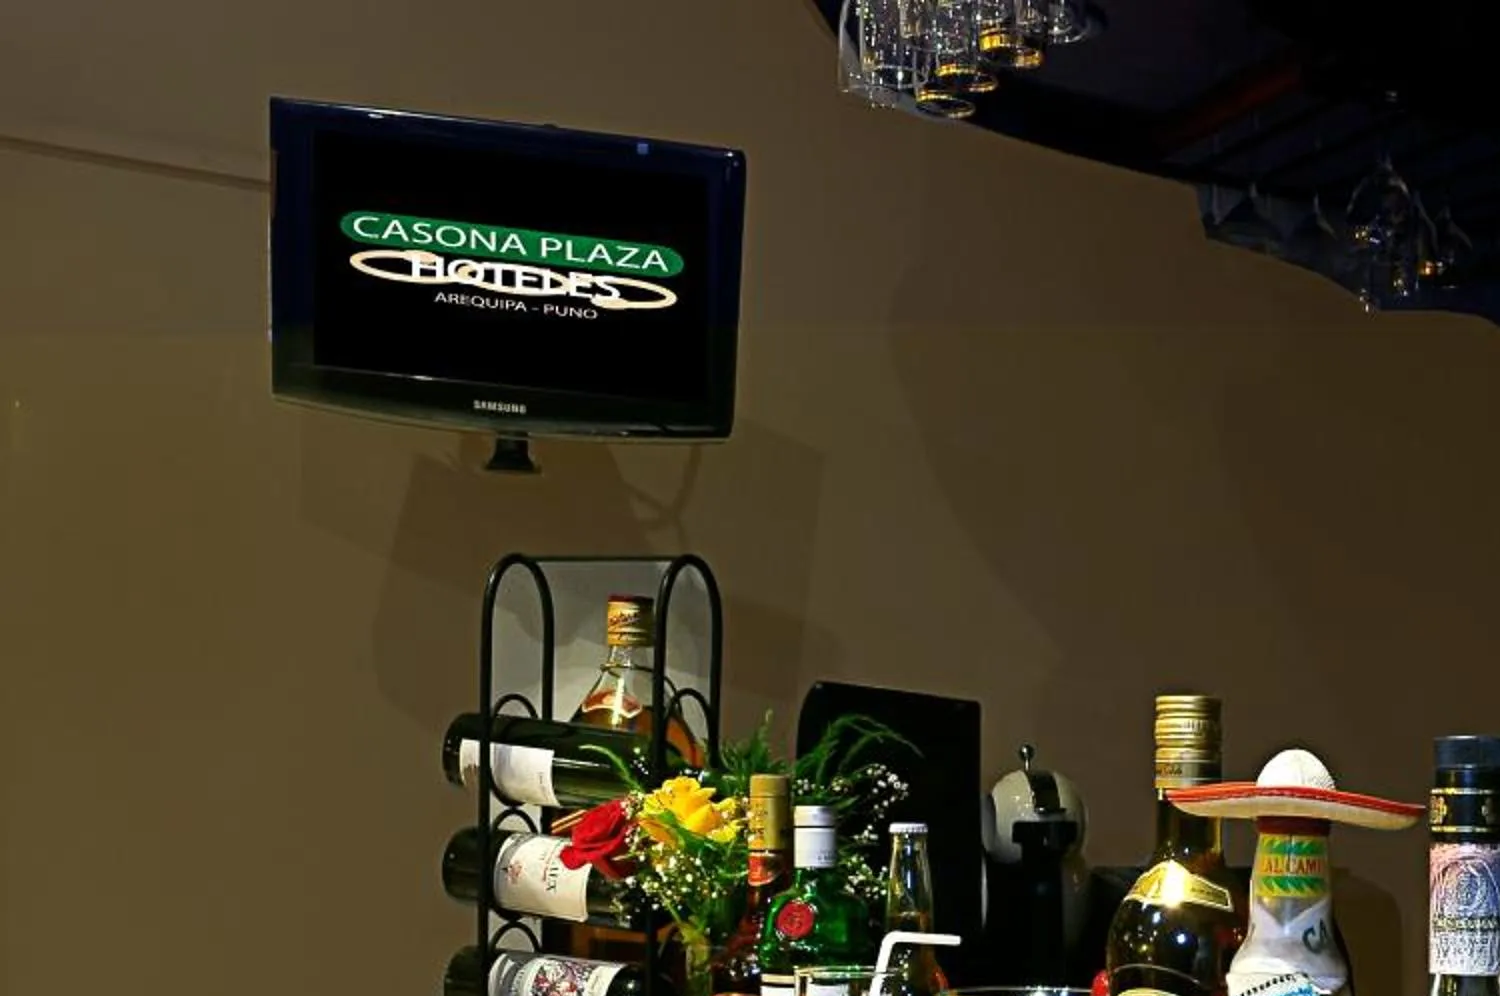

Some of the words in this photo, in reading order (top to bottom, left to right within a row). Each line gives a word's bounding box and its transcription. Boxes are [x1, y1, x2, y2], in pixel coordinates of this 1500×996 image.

[352, 215, 528, 256] CASONA
[540, 237, 669, 272] PLAZA
[434, 291, 528, 312] AREQUIPA
[543, 303, 598, 319] PUNO
